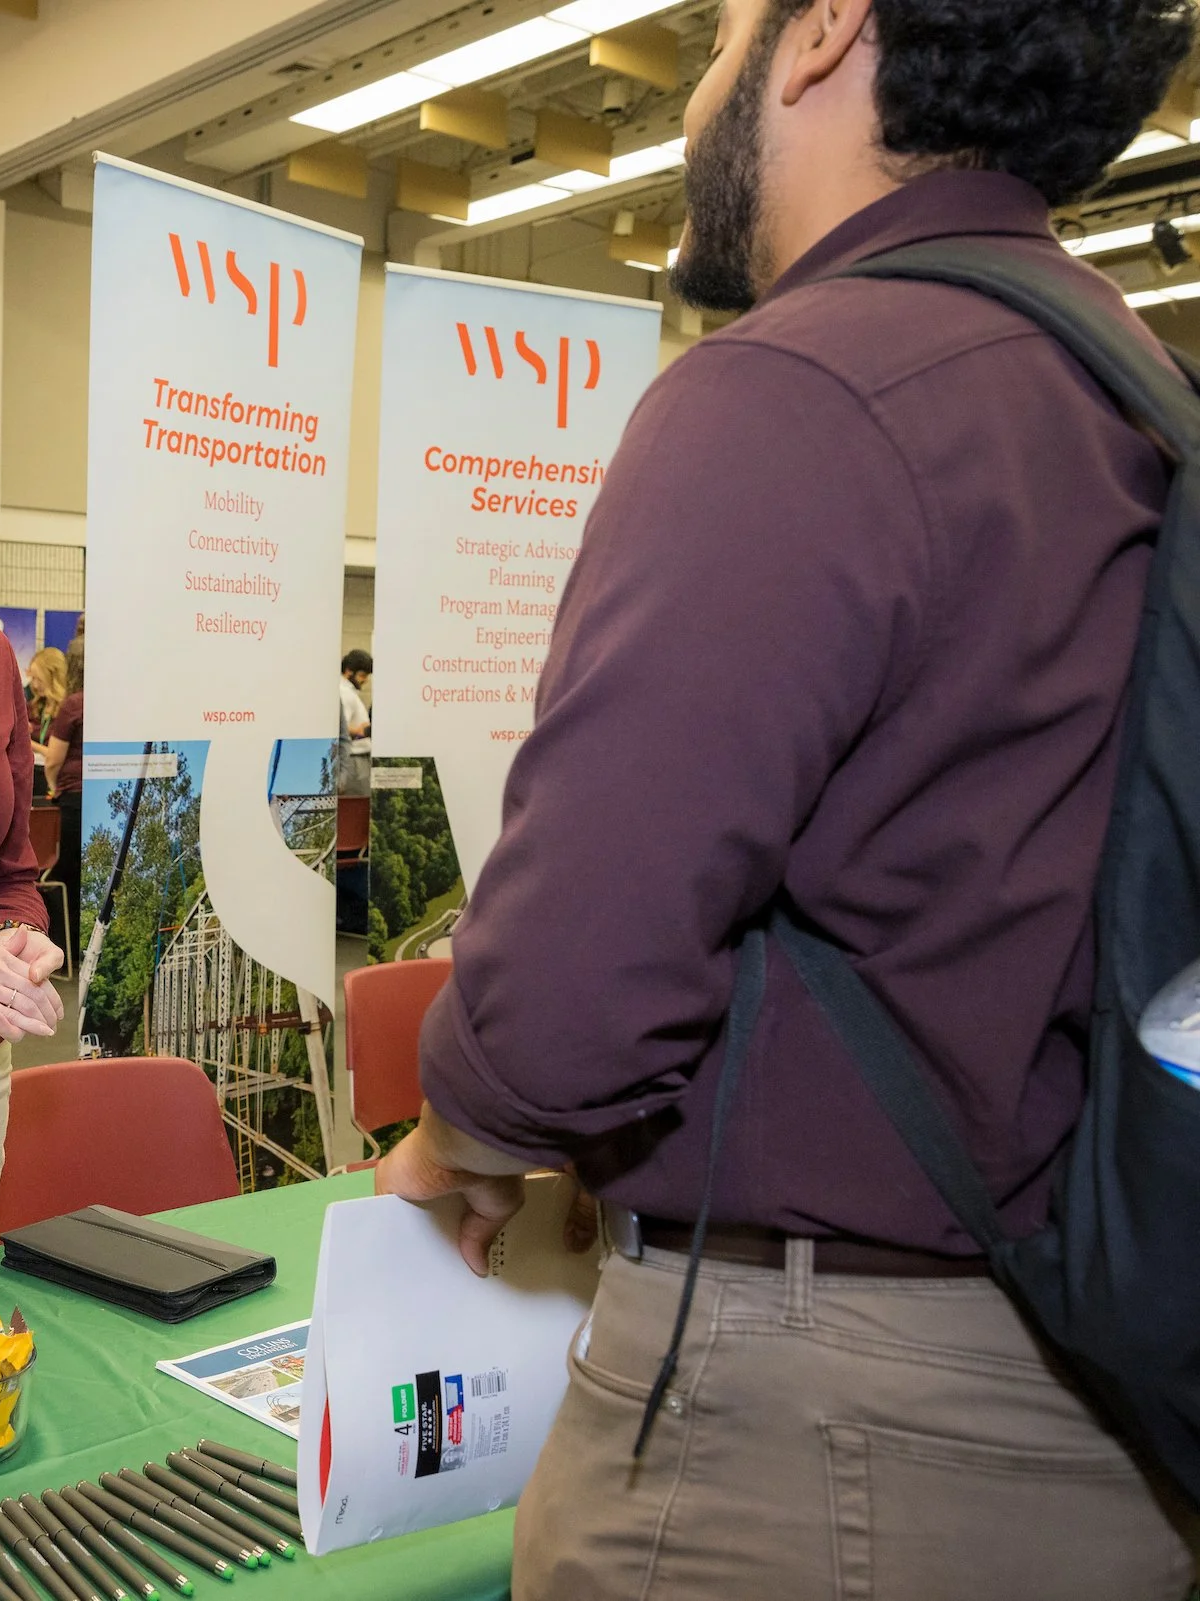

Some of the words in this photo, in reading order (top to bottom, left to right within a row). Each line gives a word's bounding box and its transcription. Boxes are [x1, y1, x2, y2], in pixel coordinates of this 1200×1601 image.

[154, 378, 319, 443] Transforming
[143, 419, 327, 476] Transportation
[204, 490, 264, 522] Mobility
[471, 486, 578, 518] Services
[188, 529, 279, 563] Connectivity
[456, 537, 520, 562] Strategic
[524, 539, 581, 560] Advisor
[185, 570, 281, 603] Sustainability
[489, 566, 556, 593] Planning
[440, 595, 502, 619] Program
[196, 612, 267, 641] Resiliency
[422, 654, 516, 674] Construction
[521, 657, 544, 674] Ma
[422, 684, 501, 707] Operations
[505, 684, 517, 702] &
[203, 709, 255, 725] wsp.com
[490, 729, 533, 743] wsp.co
[237, 1337, 291, 1356] COLLINS
[394, 1423, 412, 1436] 4
